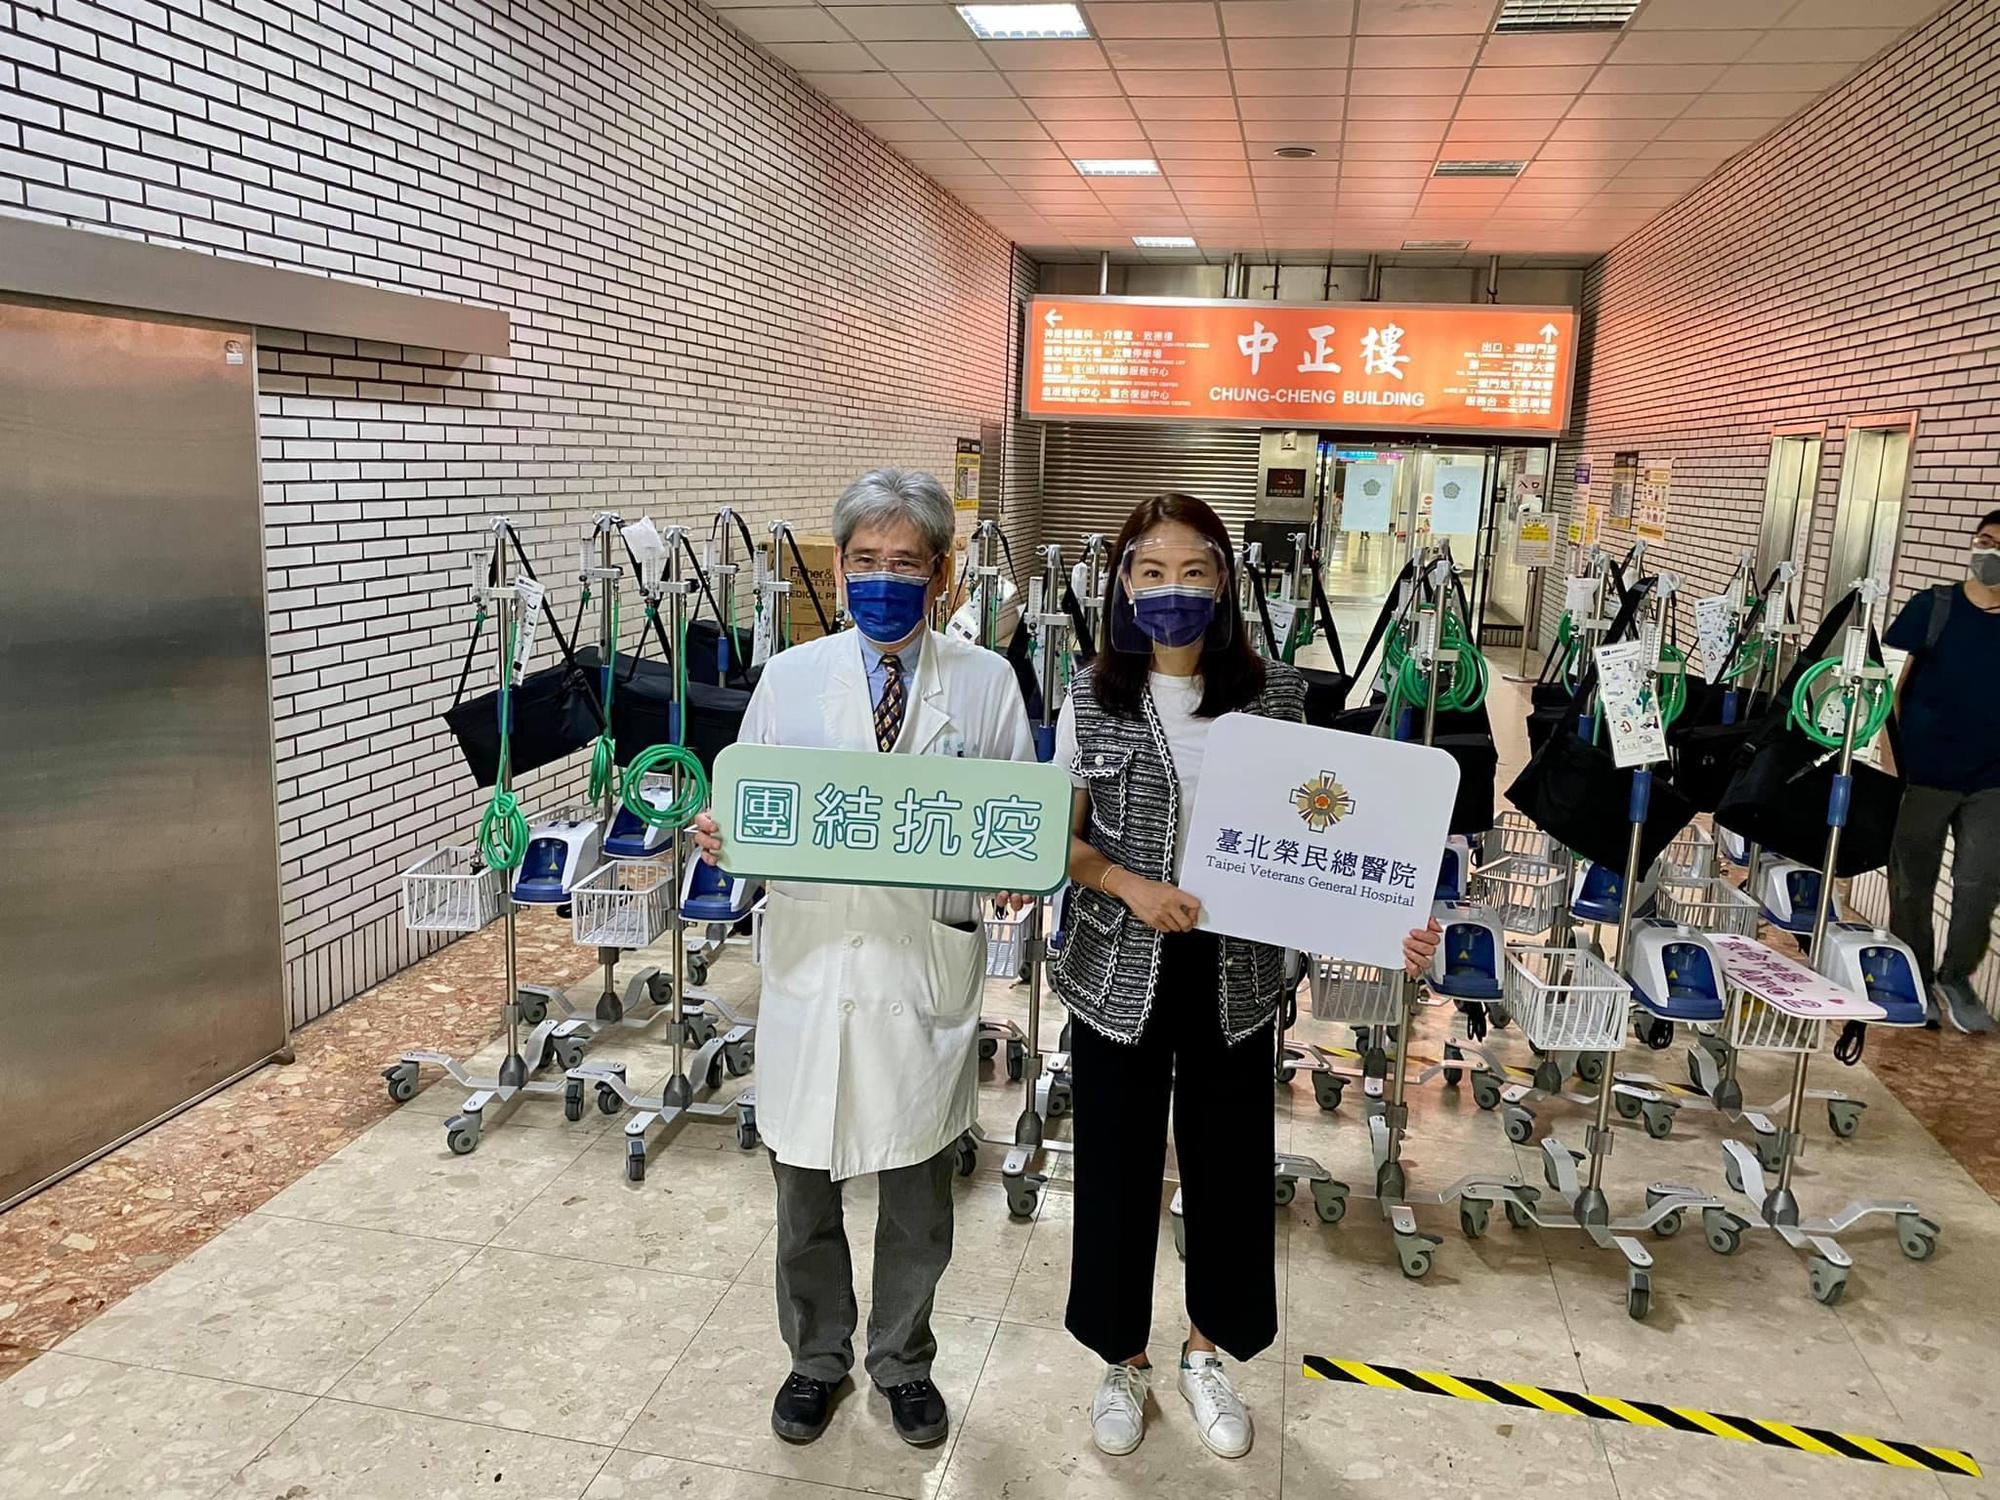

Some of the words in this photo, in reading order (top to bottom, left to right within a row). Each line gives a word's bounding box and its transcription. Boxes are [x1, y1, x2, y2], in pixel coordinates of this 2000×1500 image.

[1238, 321, 1411, 379] 中正樓
[1209, 387, 1336, 404] CHUNG-CHENG
[1343, 391, 1425, 406] BUILDING
[1518, 480, 1540, 488] 入口
[734, 778, 1041, 861] 團結抗疫
[1206, 855, 1246, 874] Taipei
[1249, 864, 1305, 886] Veterans
[1308, 876, 1357, 896] General
[1360, 886, 1415, 907] Hospital
[1216, 828, 1417, 889] 臺北榮民總醫院
